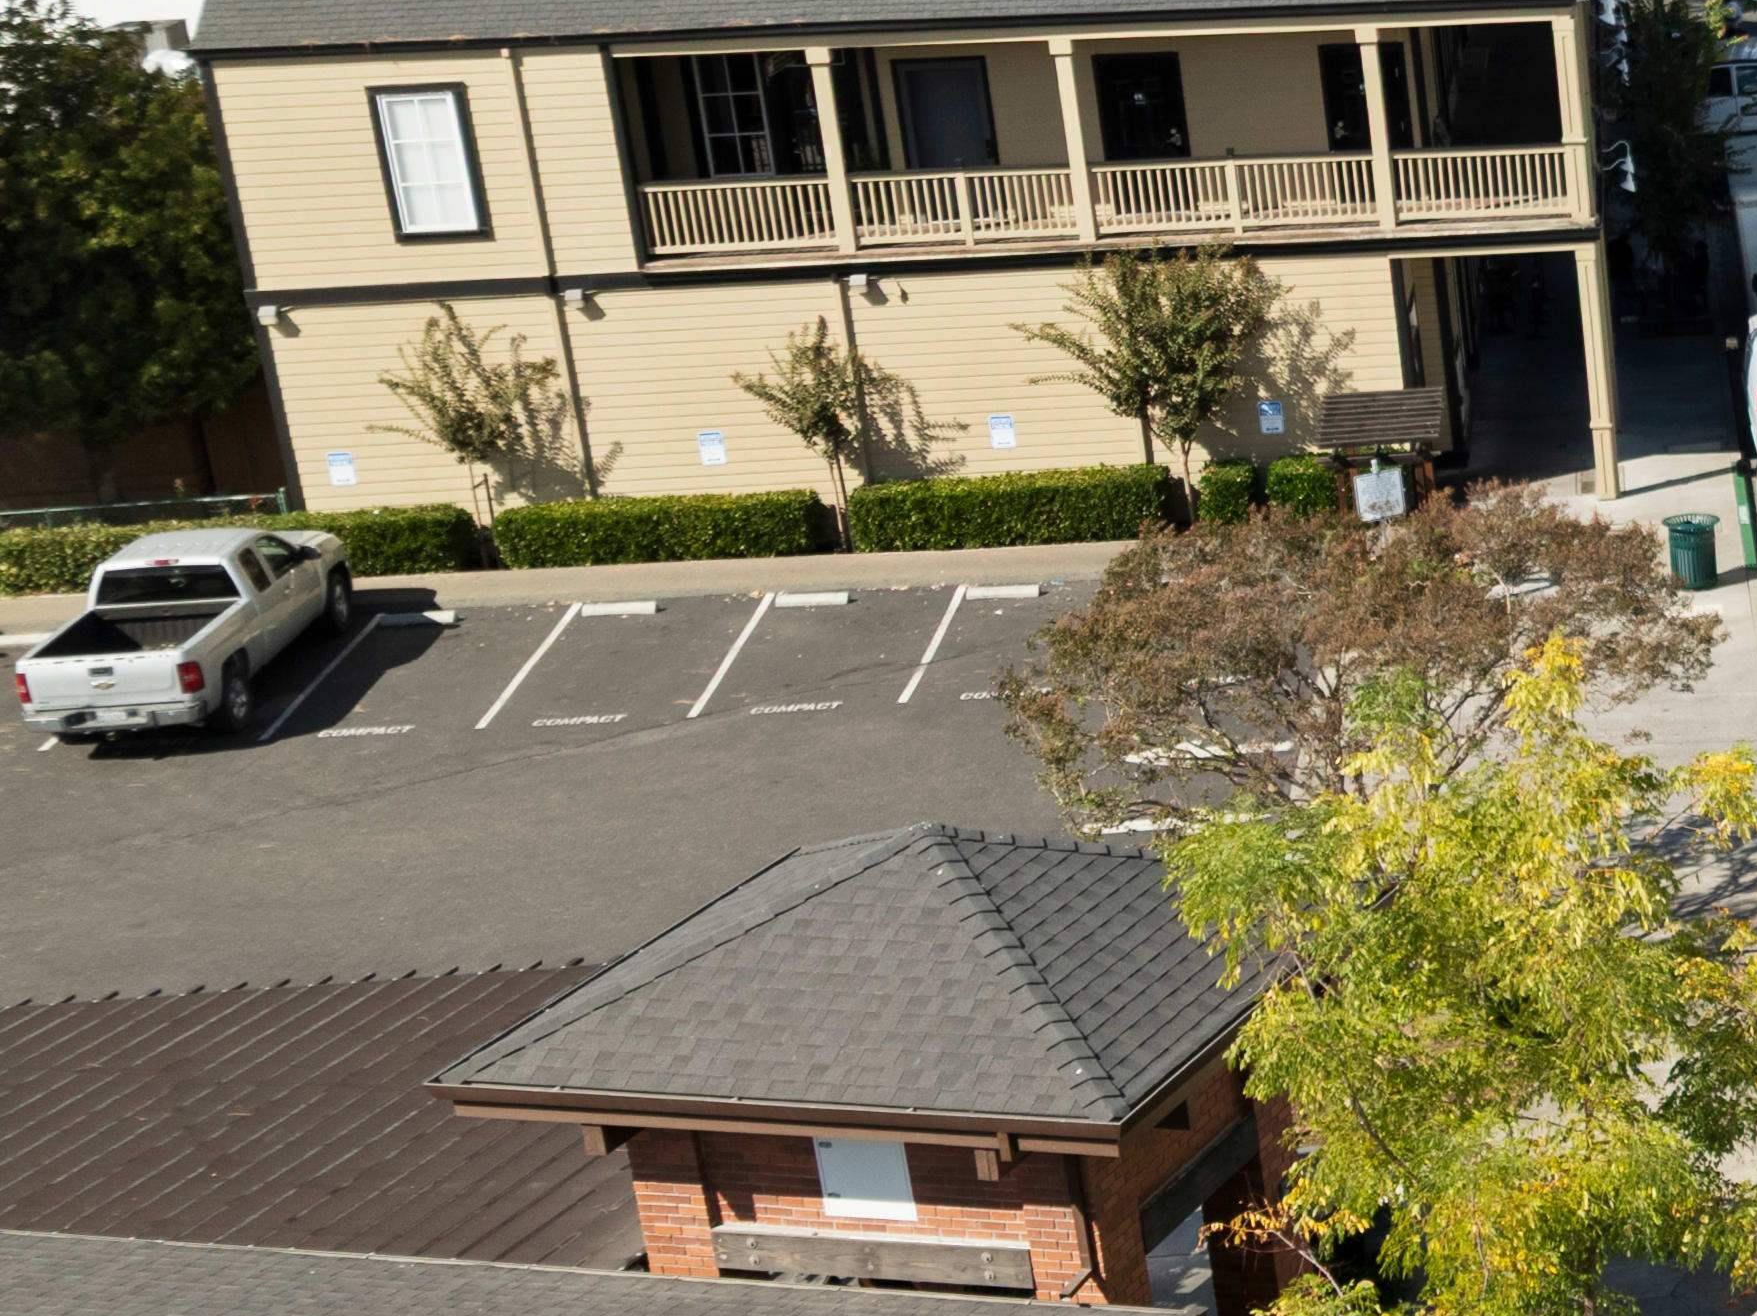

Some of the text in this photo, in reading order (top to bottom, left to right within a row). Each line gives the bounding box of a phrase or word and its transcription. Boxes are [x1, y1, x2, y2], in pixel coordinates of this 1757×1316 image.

[750, 700, 843, 715] COMPACT
[531, 713, 628, 727] COMPACT
[317, 724, 416, 738] COMPACT
